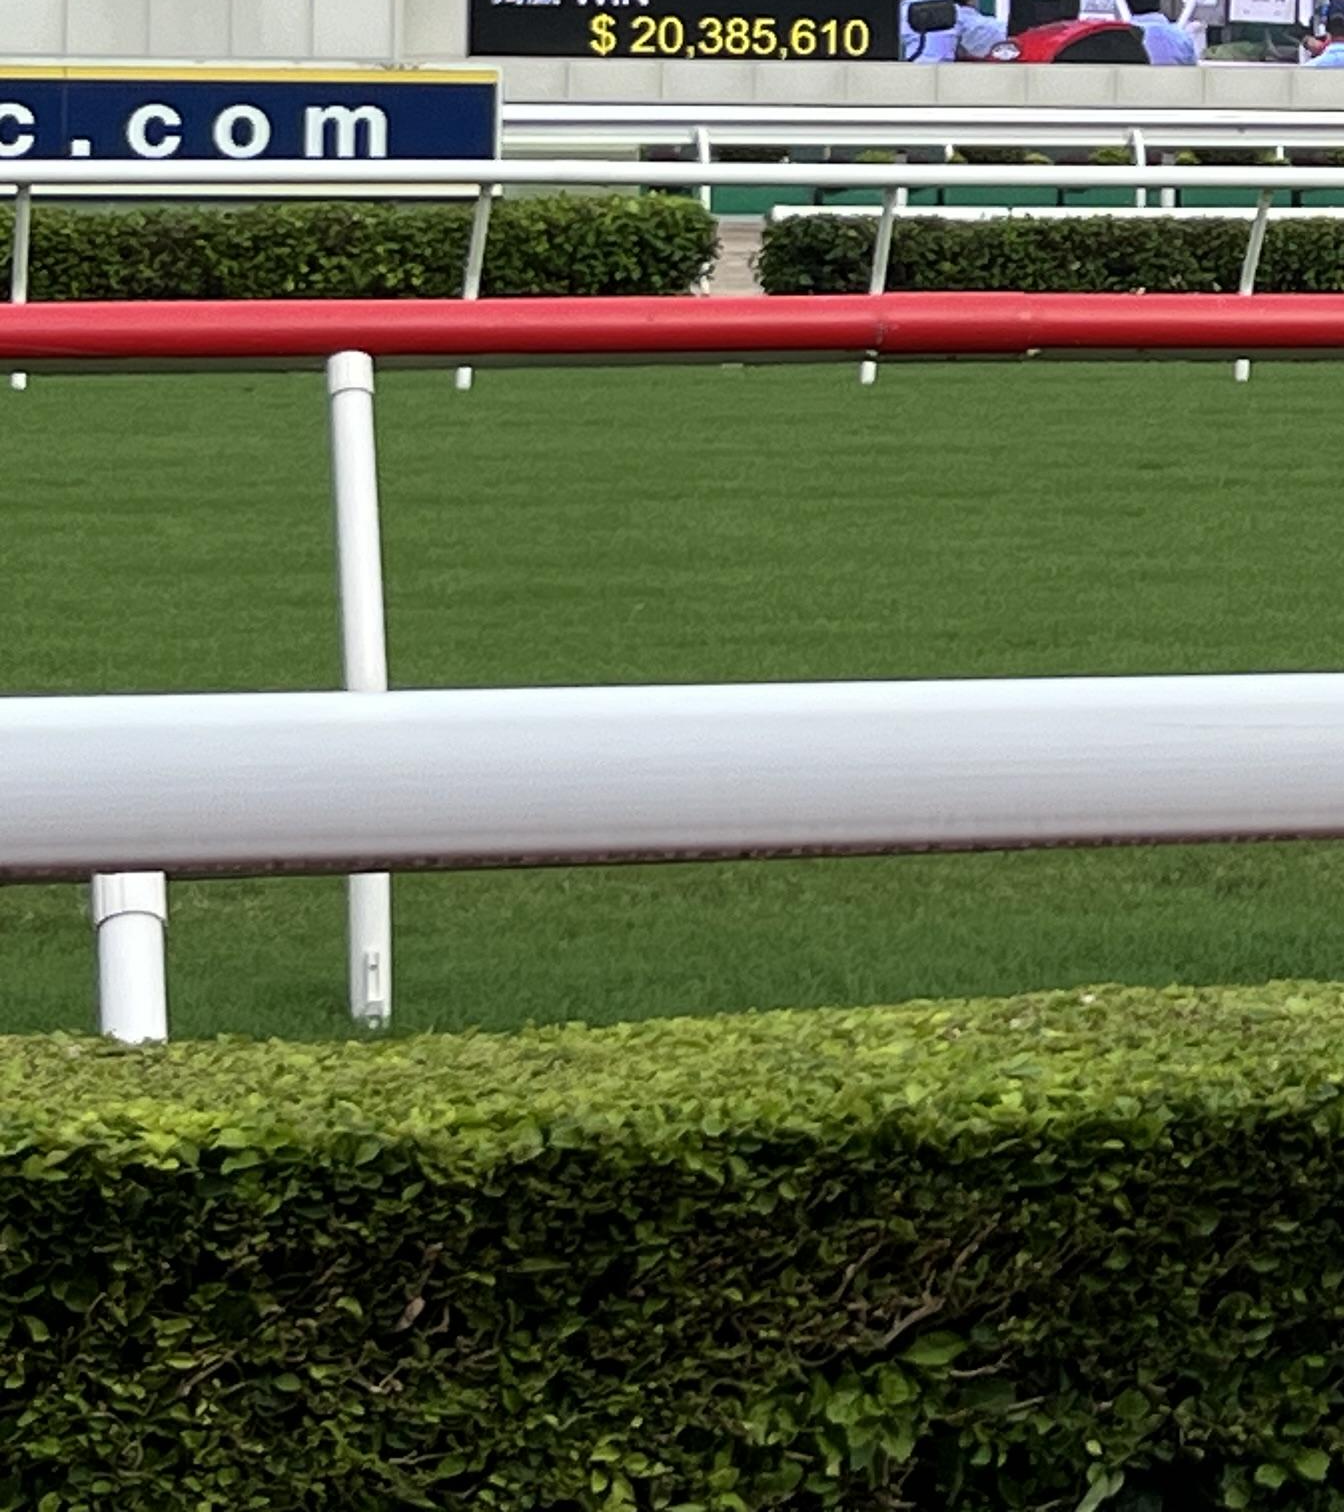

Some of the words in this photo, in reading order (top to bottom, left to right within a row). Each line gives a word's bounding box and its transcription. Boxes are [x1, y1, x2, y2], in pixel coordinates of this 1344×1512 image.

[590, 14, 616, 55] $
[628, 16, 868, 61] 20,385,610
[0, 103, 388, 158] c.com
